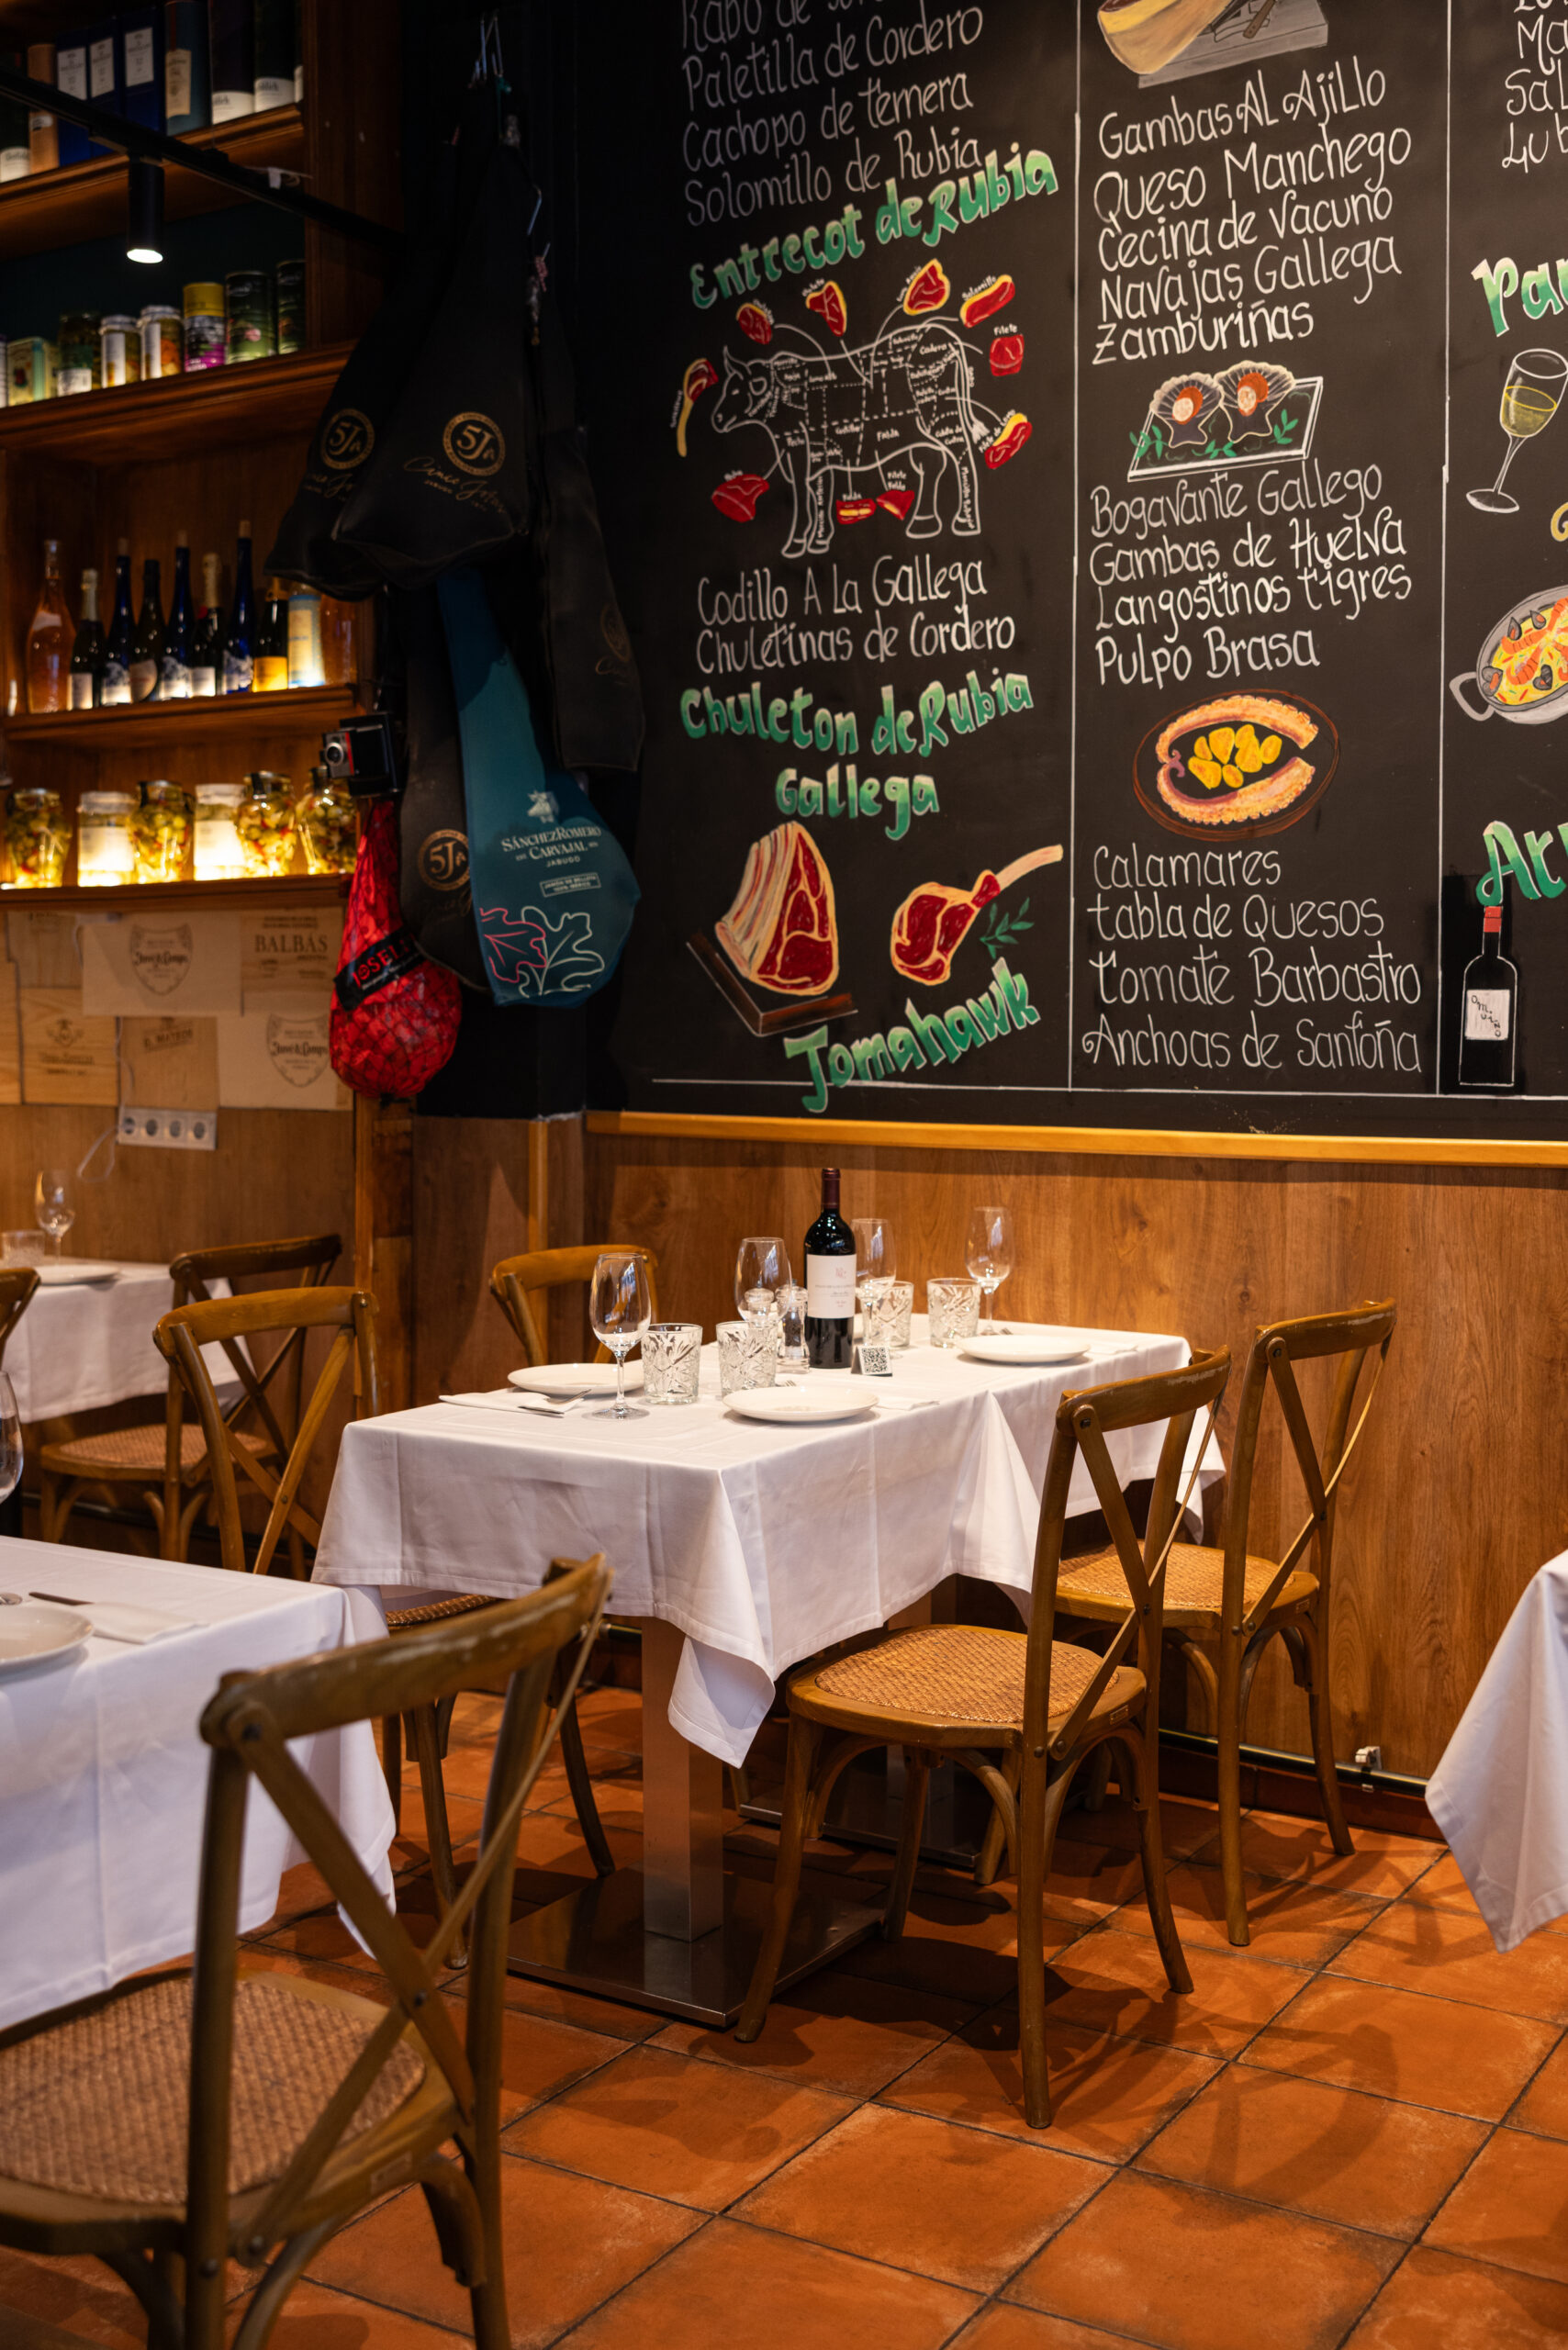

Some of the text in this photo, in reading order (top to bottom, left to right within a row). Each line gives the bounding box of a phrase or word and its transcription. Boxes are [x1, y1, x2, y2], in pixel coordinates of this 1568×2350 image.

[682, 2, 982, 111] Paletilla de Cordero
[683, 109, 806, 172] Cachopo
[821, 87, 855, 139] de
[1099, 95, 1234, 159] Gambas
[685, 126, 983, 226] Solomillo de Rubia
[1093, 123, 1412, 234] Queso Manchego
[690, 142, 1059, 309] Entrecot de Rubia
[1218, 199, 1258, 252] de
[1101, 235, 1403, 321] Navajas Gallega
[1090, 458, 1382, 541] Bogavante Gallego
[1090, 506, 1406, 586] Gambas de Huelva
[698, 567, 789, 626] Codillo
[803, 566, 822, 615] A
[872, 553, 988, 614] Gallega
[1095, 571, 1291, 643] Langostinos
[695, 621, 854, 674] Chuletinas
[864, 610, 899, 663] de
[910, 606, 1015, 658] Cordero
[1095, 625, 1321, 689] Pulpo Brasa
[679, 667, 1035, 757] Chuleton de Rubia
[775, 762, 940, 841] Gallega
[1093, 842, 1282, 890] Calamares
[1193, 893, 1233, 940] de
[1242, 893, 1384, 943] Quesos
[1249, 940, 1422, 1007] Barbastro
[783, 957, 1041, 1113] Tomahawk
[1081, 1013, 1231, 1069] Anchoas
[1240, 1010, 1282, 1069] de
